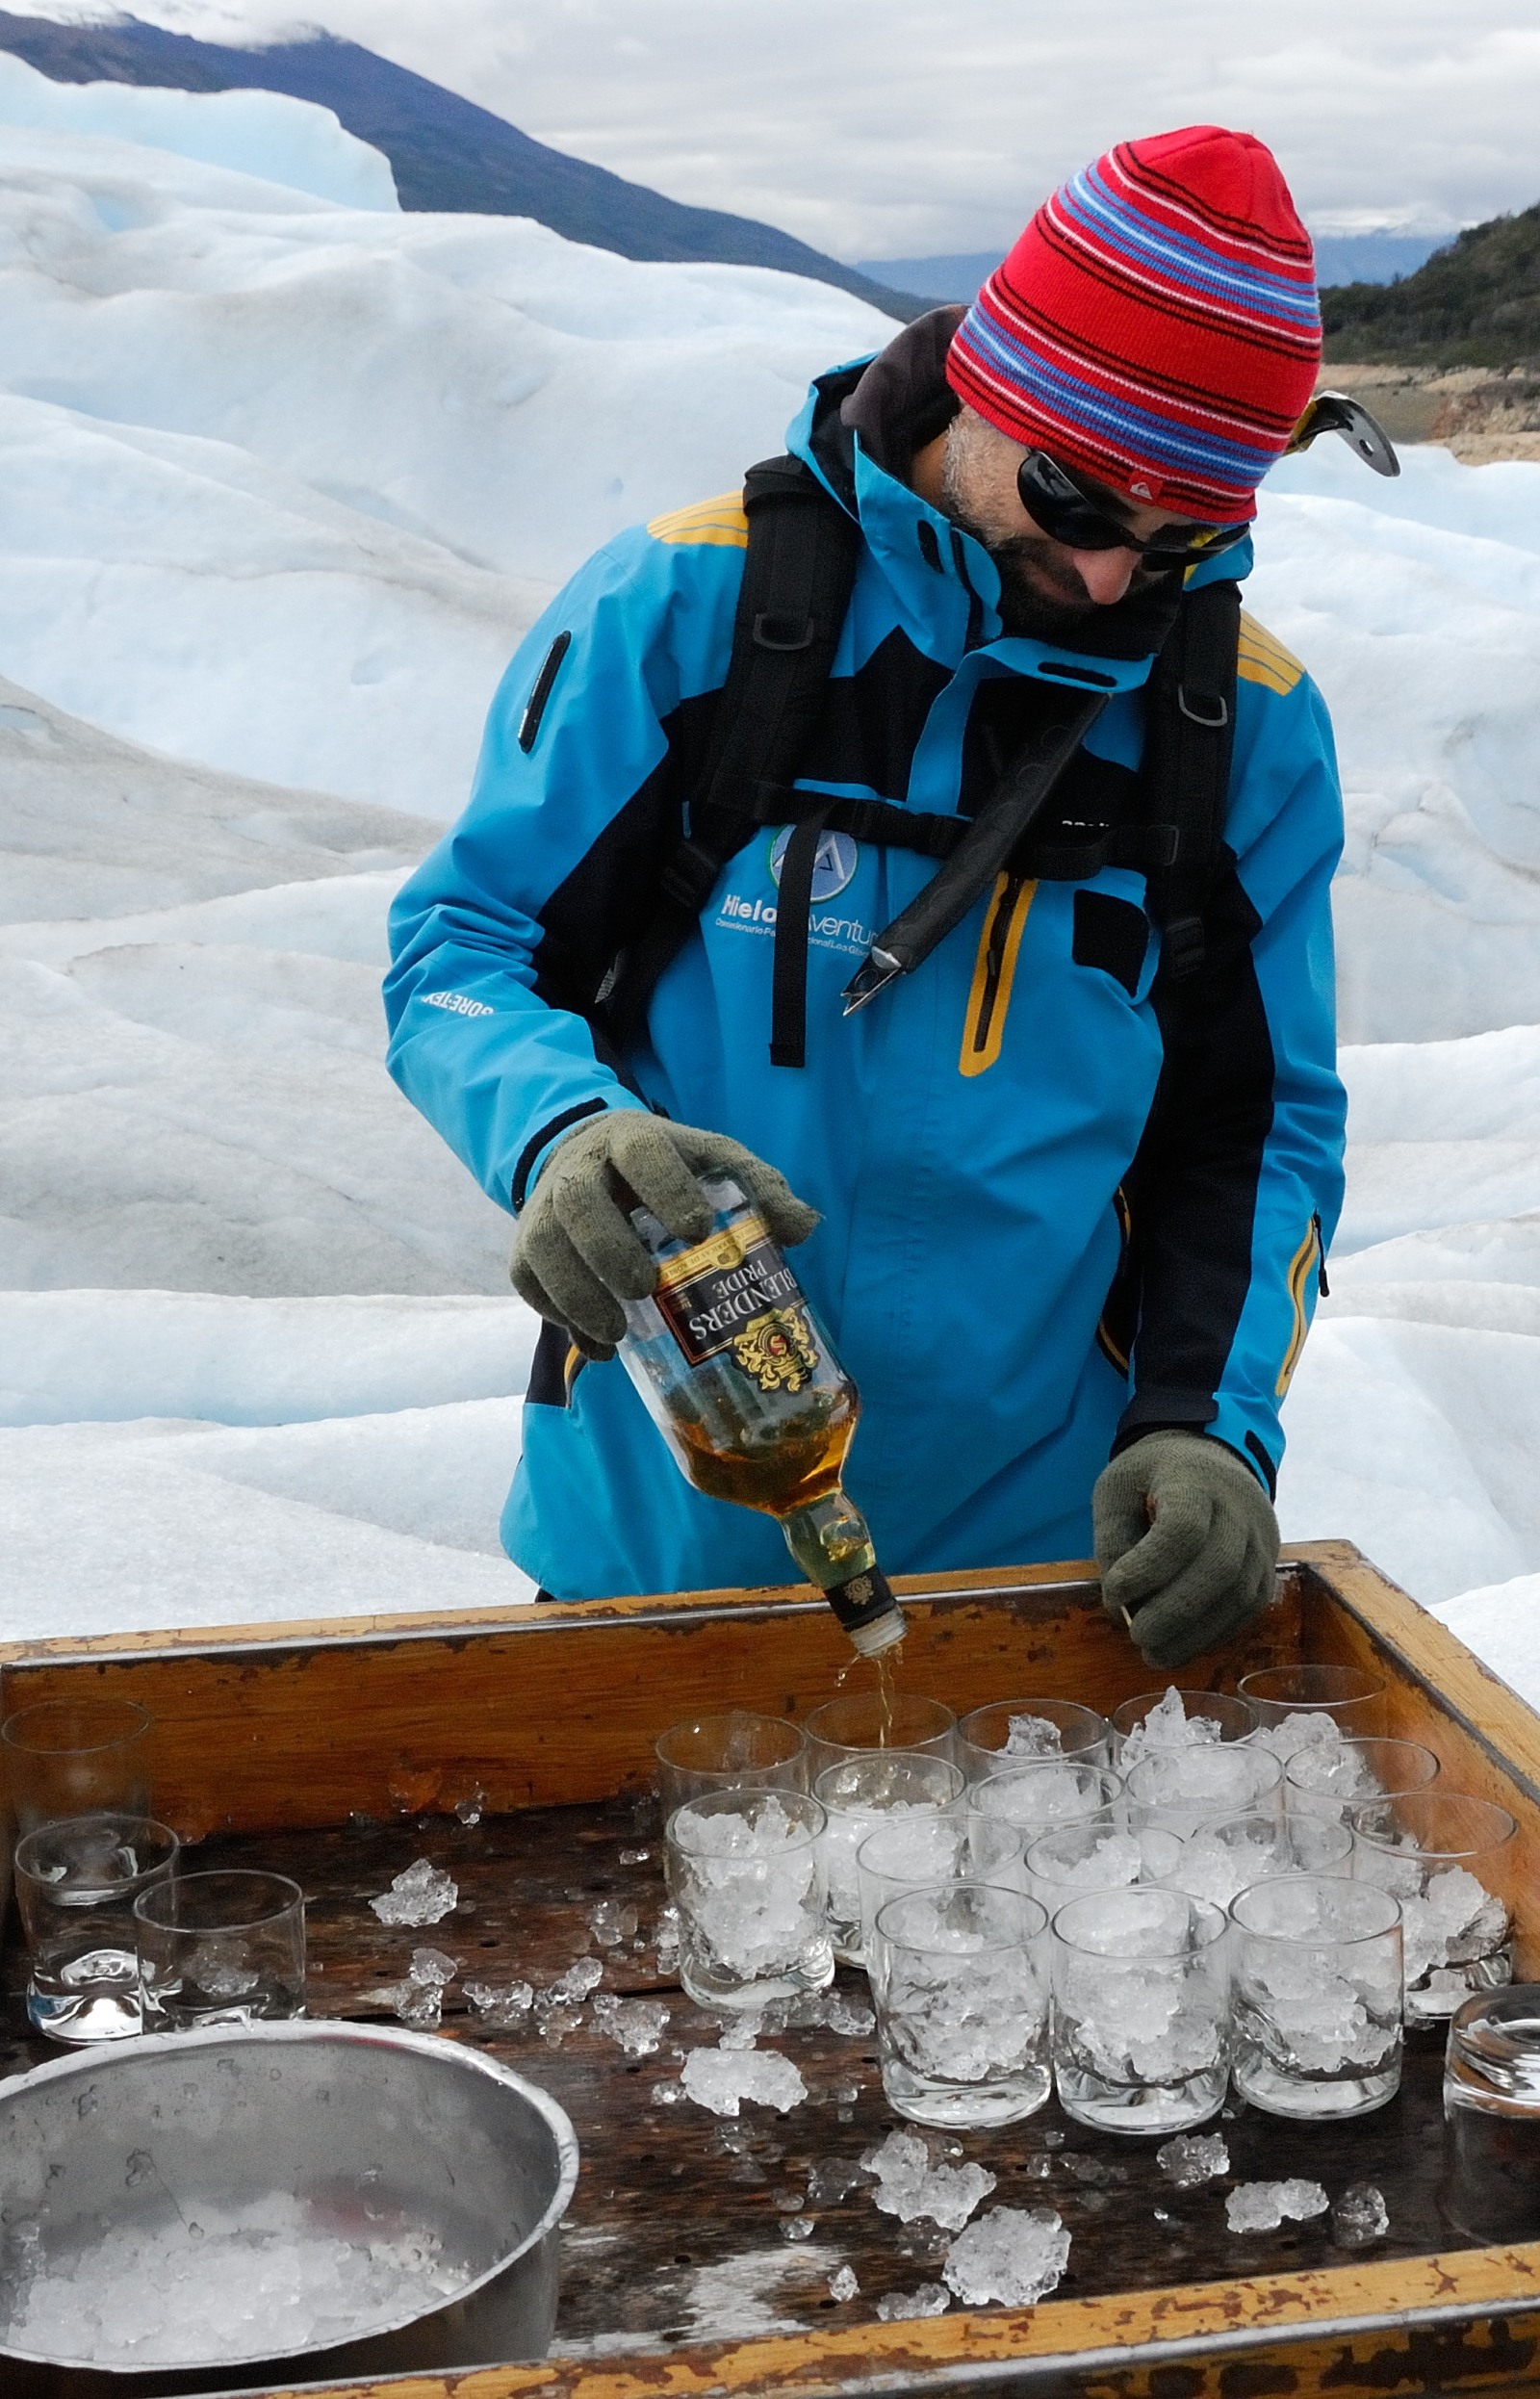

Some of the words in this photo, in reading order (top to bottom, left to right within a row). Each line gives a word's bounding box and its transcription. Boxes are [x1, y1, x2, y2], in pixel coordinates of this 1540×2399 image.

[721, 893, 778, 923] Hielo
[712, 1259, 768, 1300] PRIDE
[688, 1267, 798, 1341] BLENDERS
